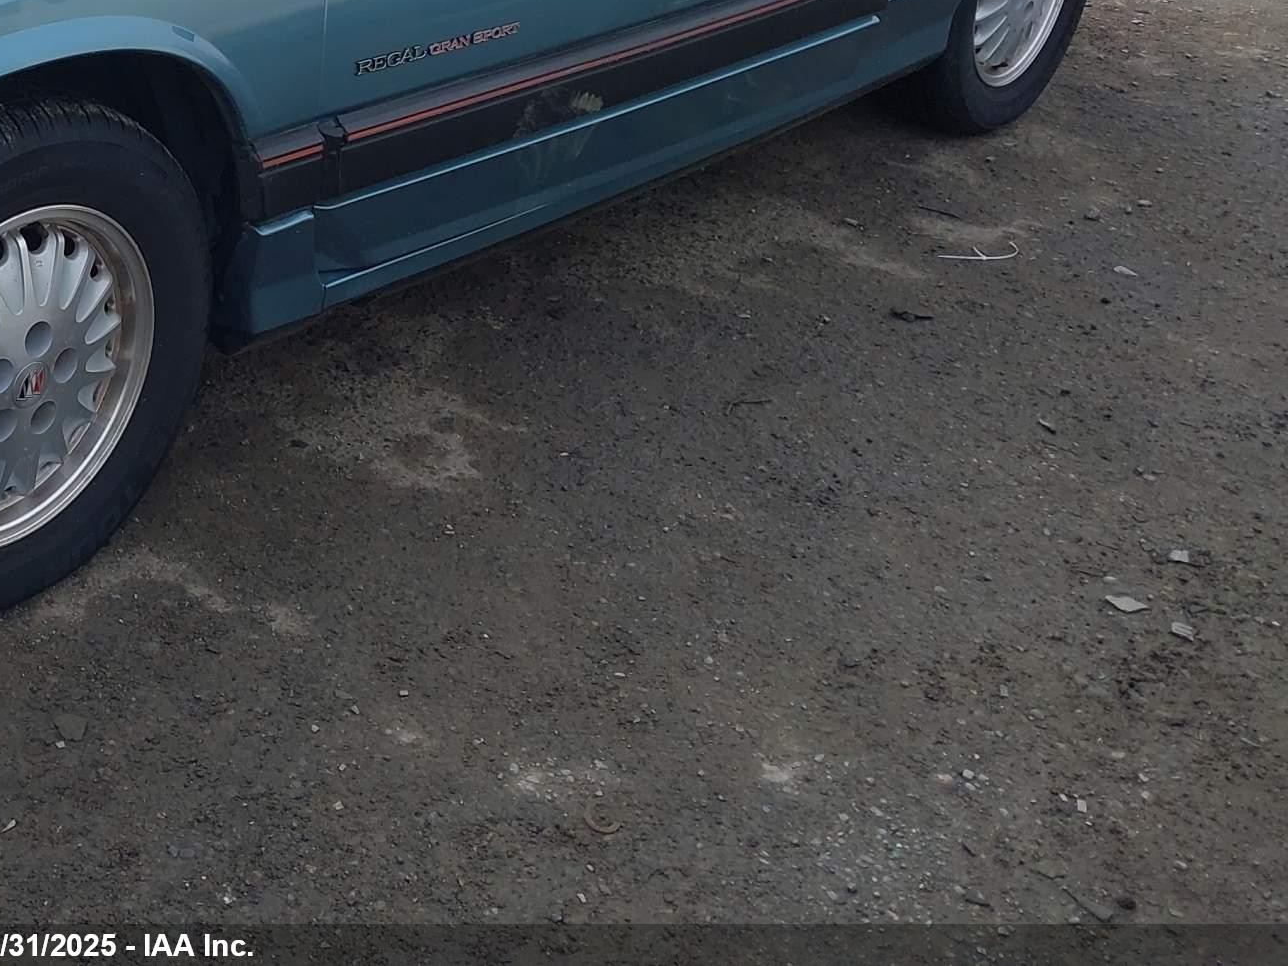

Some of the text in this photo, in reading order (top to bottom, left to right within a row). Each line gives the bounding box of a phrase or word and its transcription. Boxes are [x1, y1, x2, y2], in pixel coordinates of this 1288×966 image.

[357, 22, 520, 75] REGAL GRAN SPORT
